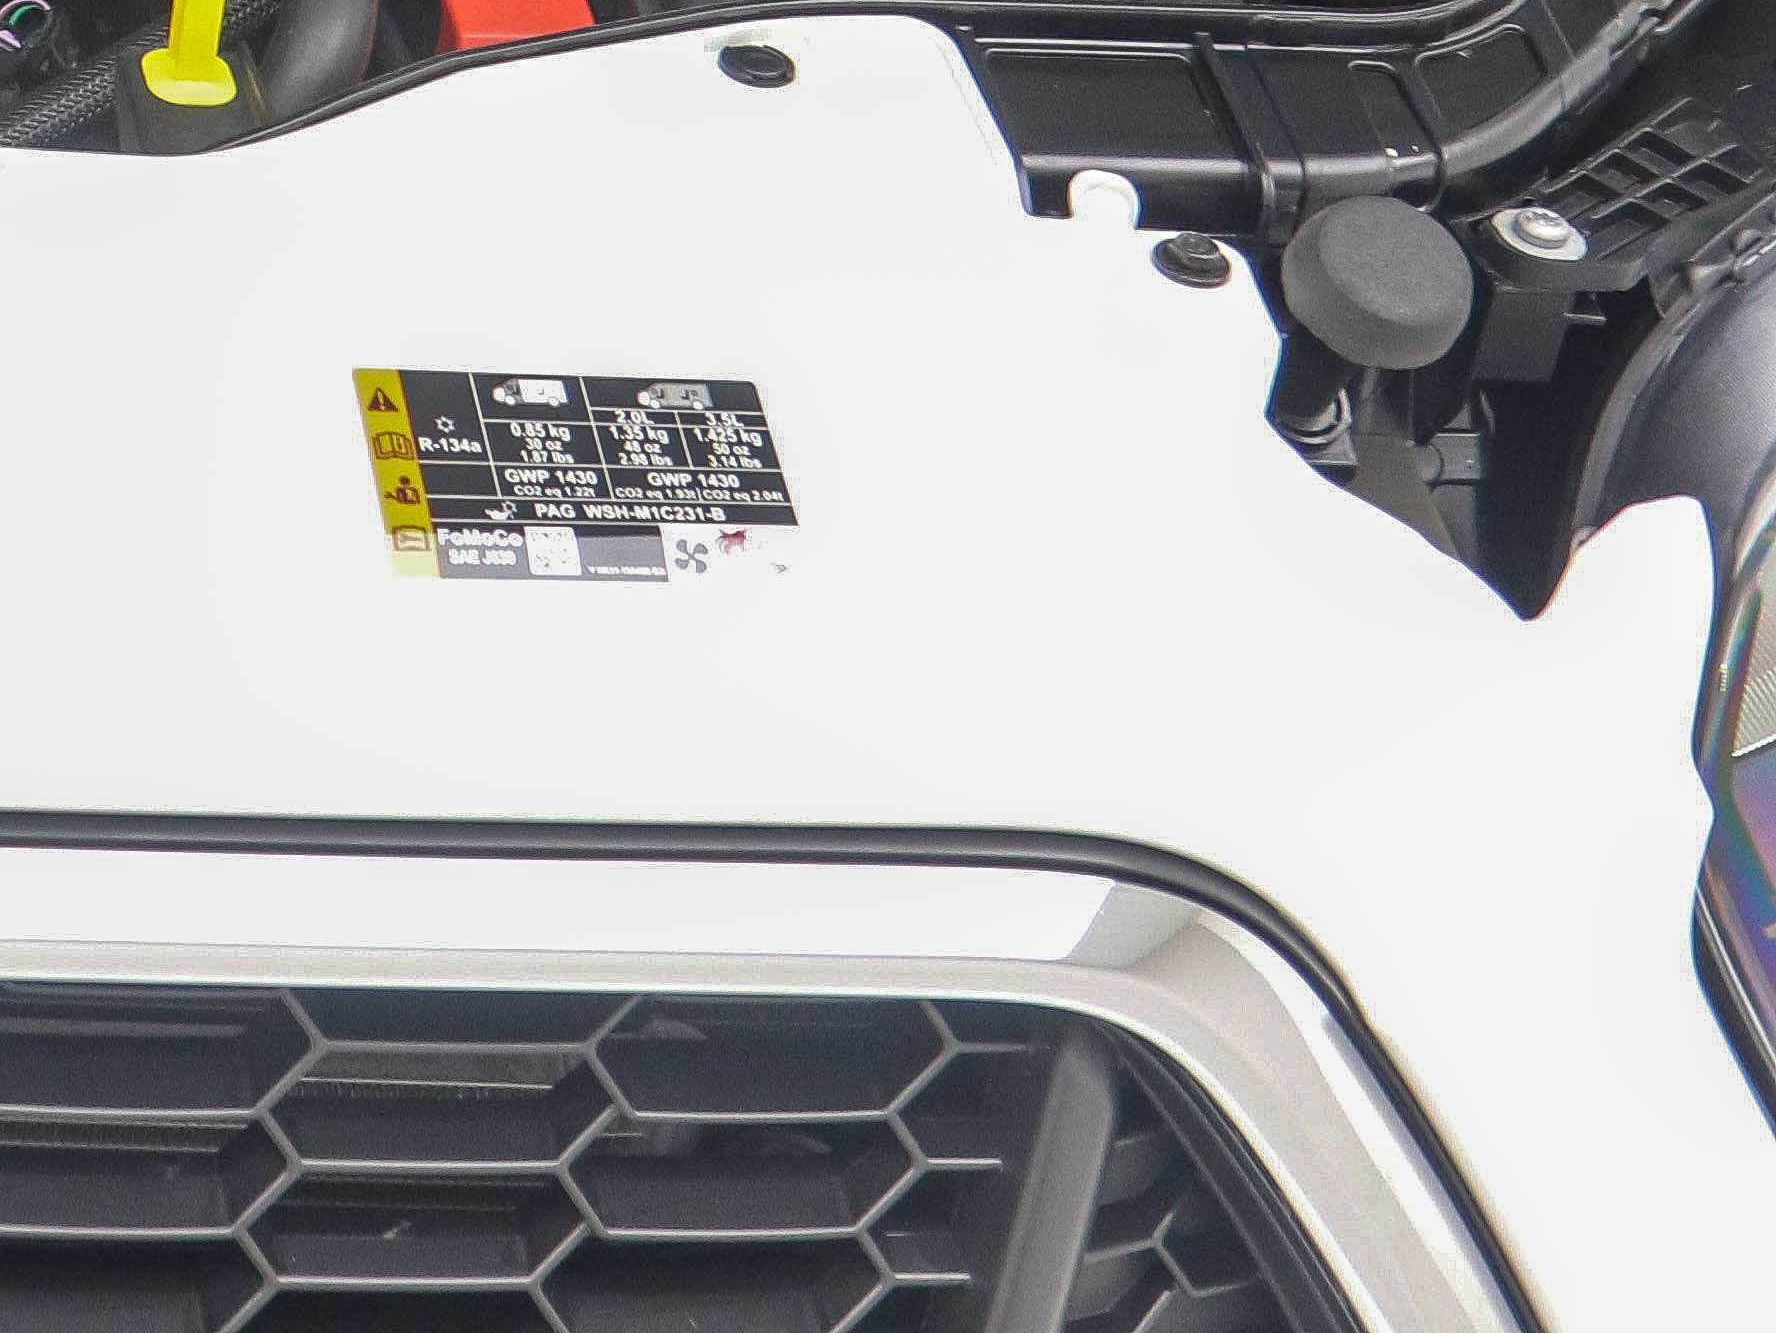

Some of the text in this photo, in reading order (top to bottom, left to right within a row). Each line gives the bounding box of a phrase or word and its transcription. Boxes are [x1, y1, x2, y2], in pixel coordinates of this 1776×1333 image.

[614, 409, 655, 425] 2.0L
[704, 411, 745, 427] 3.5L
[509, 421, 571, 442] 0.85 kg
[609, 425, 670, 445] 1.35 kg
[694, 428, 763, 447] 1.425 kg
[418, 436, 483, 454] R-134a
[525, 438, 564, 452] 30 oz
[644, 442, 663, 454] oz
[712, 443, 752, 456] 50 oz
[520, 450, 575, 464] 1.87 lbs
[650, 453, 673, 467] lbs
[707, 455, 763, 470] 3.14 lbs
[504, 468, 598, 485] GWP 1430
[647, 471, 741, 489] GWP 1430
[513, 485, 542, 497] CO2
[544, 488, 562, 499] eq
[615, 487, 644, 498] CO2
[645, 489, 664, 501] eq
[702, 489, 732, 501] CO2
[733, 491, 751, 502] eq
[535, 503, 727, 522] PAG WSH-M1C231-B
[437, 528, 524, 548] FoMoCo
